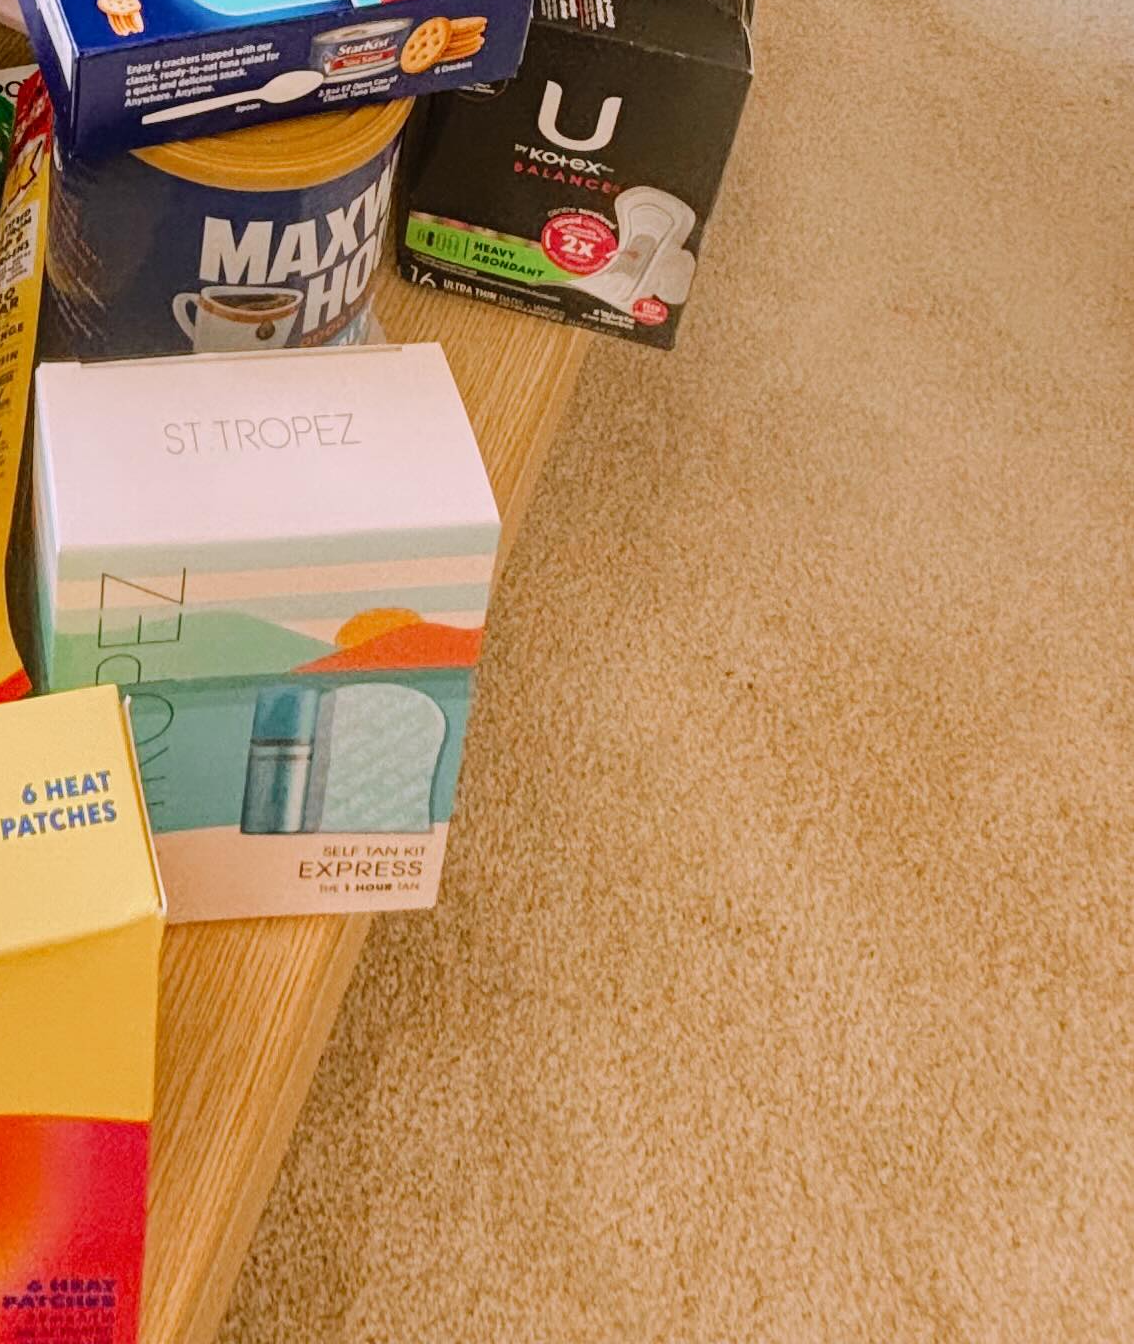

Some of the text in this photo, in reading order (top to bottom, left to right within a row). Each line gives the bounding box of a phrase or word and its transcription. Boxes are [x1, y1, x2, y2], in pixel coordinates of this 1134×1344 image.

[126, 63, 152, 76] Enjoy
[162, 54, 201, 69] crackers
[201, 47, 234, 62] topped
[235, 44, 256, 56] with
[241, 53, 266, 66] salad
[538, 80, 623, 151] U
[513, 161, 612, 194] BALANCE
[471, 252, 546, 279] ABONDANT
[473, 241, 516, 260] HEAVY
[212, 412, 362, 454] TROPEZ
[21, 769, 111, 806] 6 HEAT
[0, 798, 118, 841] PATCHES
[322, 845, 426, 857] SELF TAN KIT
[298, 860, 423, 879] EXPRESS
